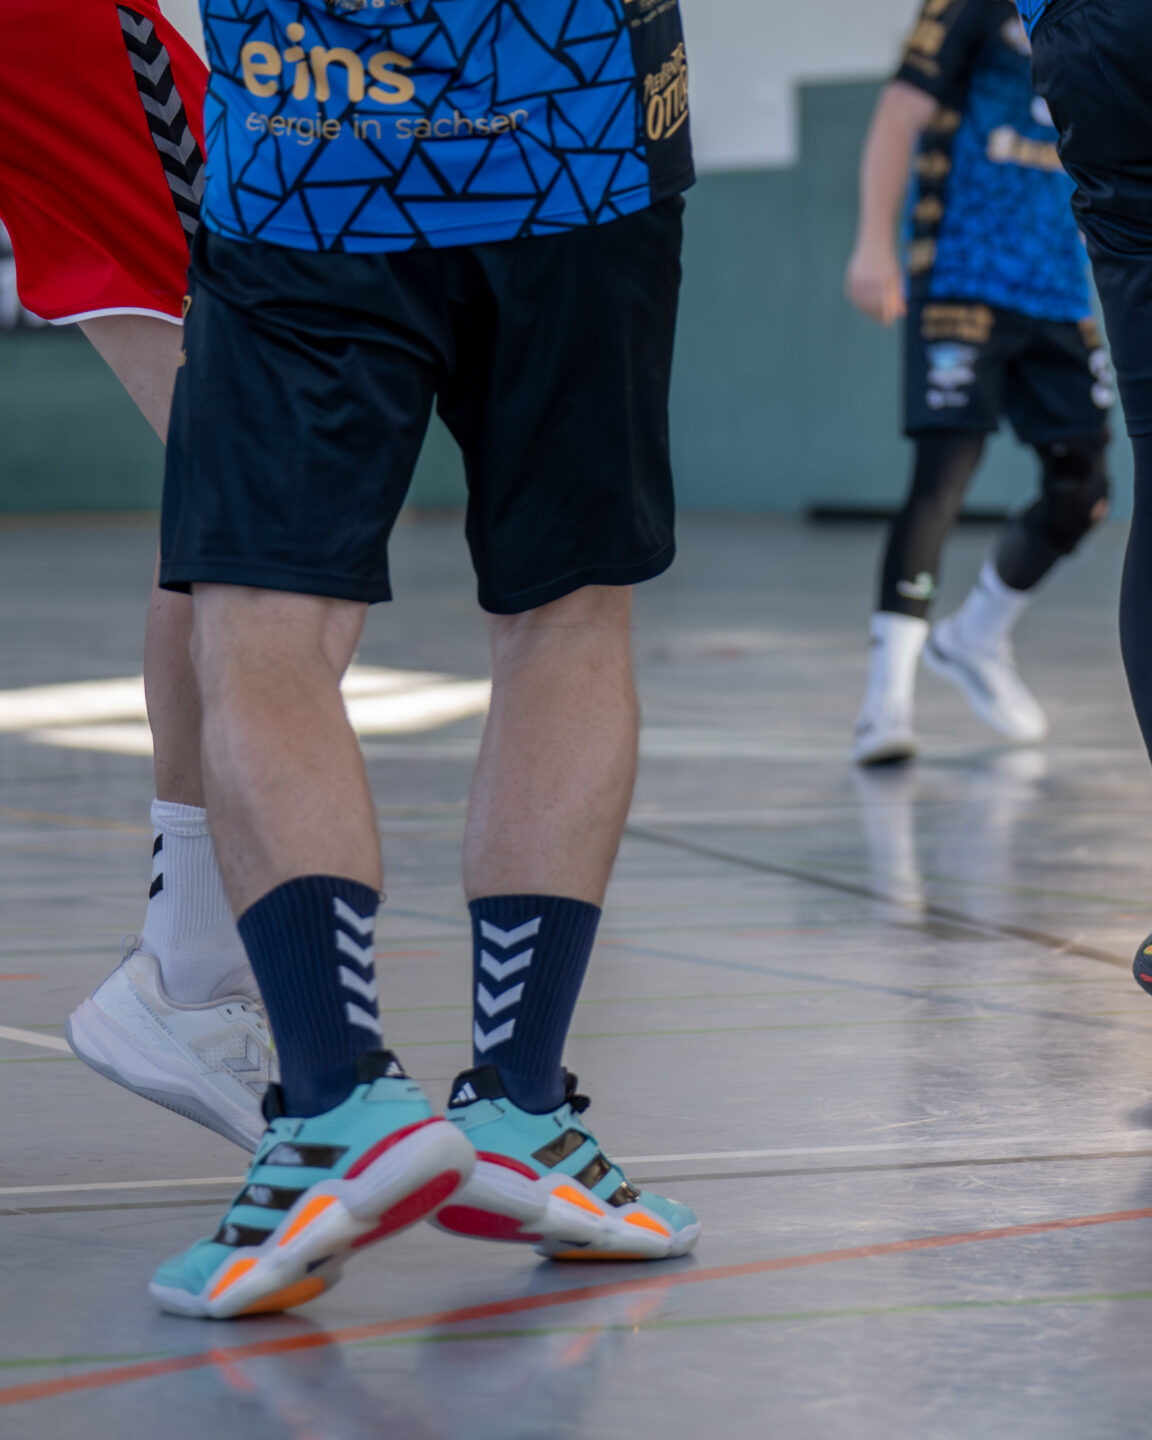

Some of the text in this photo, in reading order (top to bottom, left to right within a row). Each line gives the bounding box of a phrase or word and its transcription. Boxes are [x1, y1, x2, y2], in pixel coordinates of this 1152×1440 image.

[240, 22, 416, 106] eins
[246, 109, 528, 147] energie in sachsen
